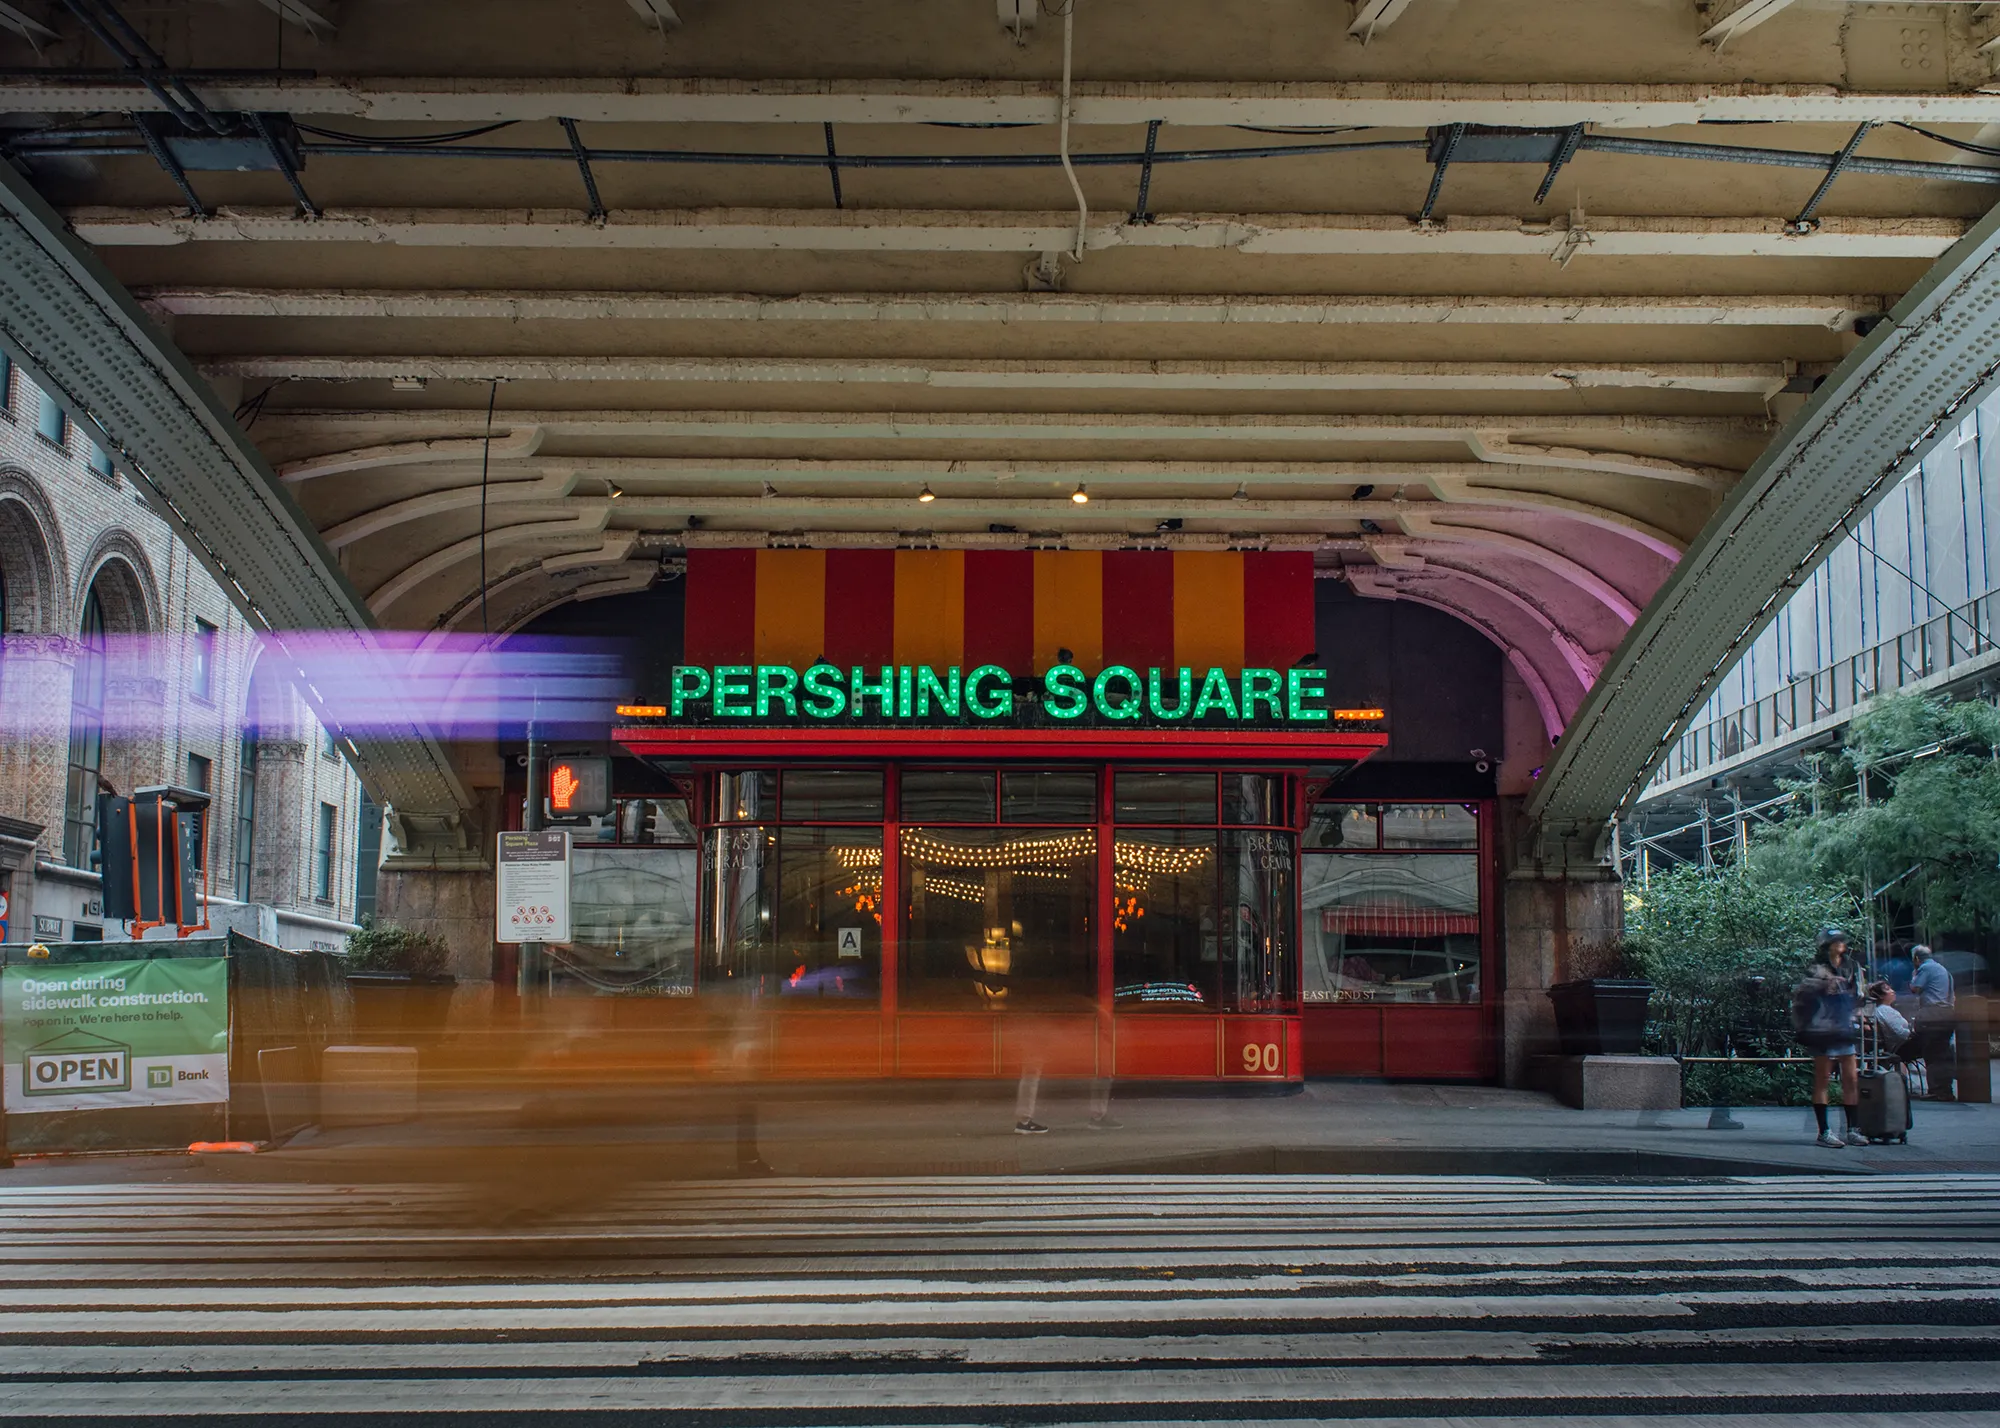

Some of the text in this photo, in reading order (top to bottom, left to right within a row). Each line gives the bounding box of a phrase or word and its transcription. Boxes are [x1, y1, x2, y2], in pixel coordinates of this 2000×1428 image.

[672, 664, 1327, 720] PERSHING SQUARE
[842, 931, 857, 948] A
[22, 976, 126, 995] Open during
[665, 985, 694, 995] 42ND
[1303, 989, 1376, 1000] EAST 42ND ST
[22, 990, 209, 1010] sidewalk construction.
[24, 1009, 183, 1028] Pop on in. We're here to help.
[1243, 1043, 1279, 1072] 90
[36, 1057, 119, 1084] OPEN
[148, 1069, 209, 1086] TD Bank
